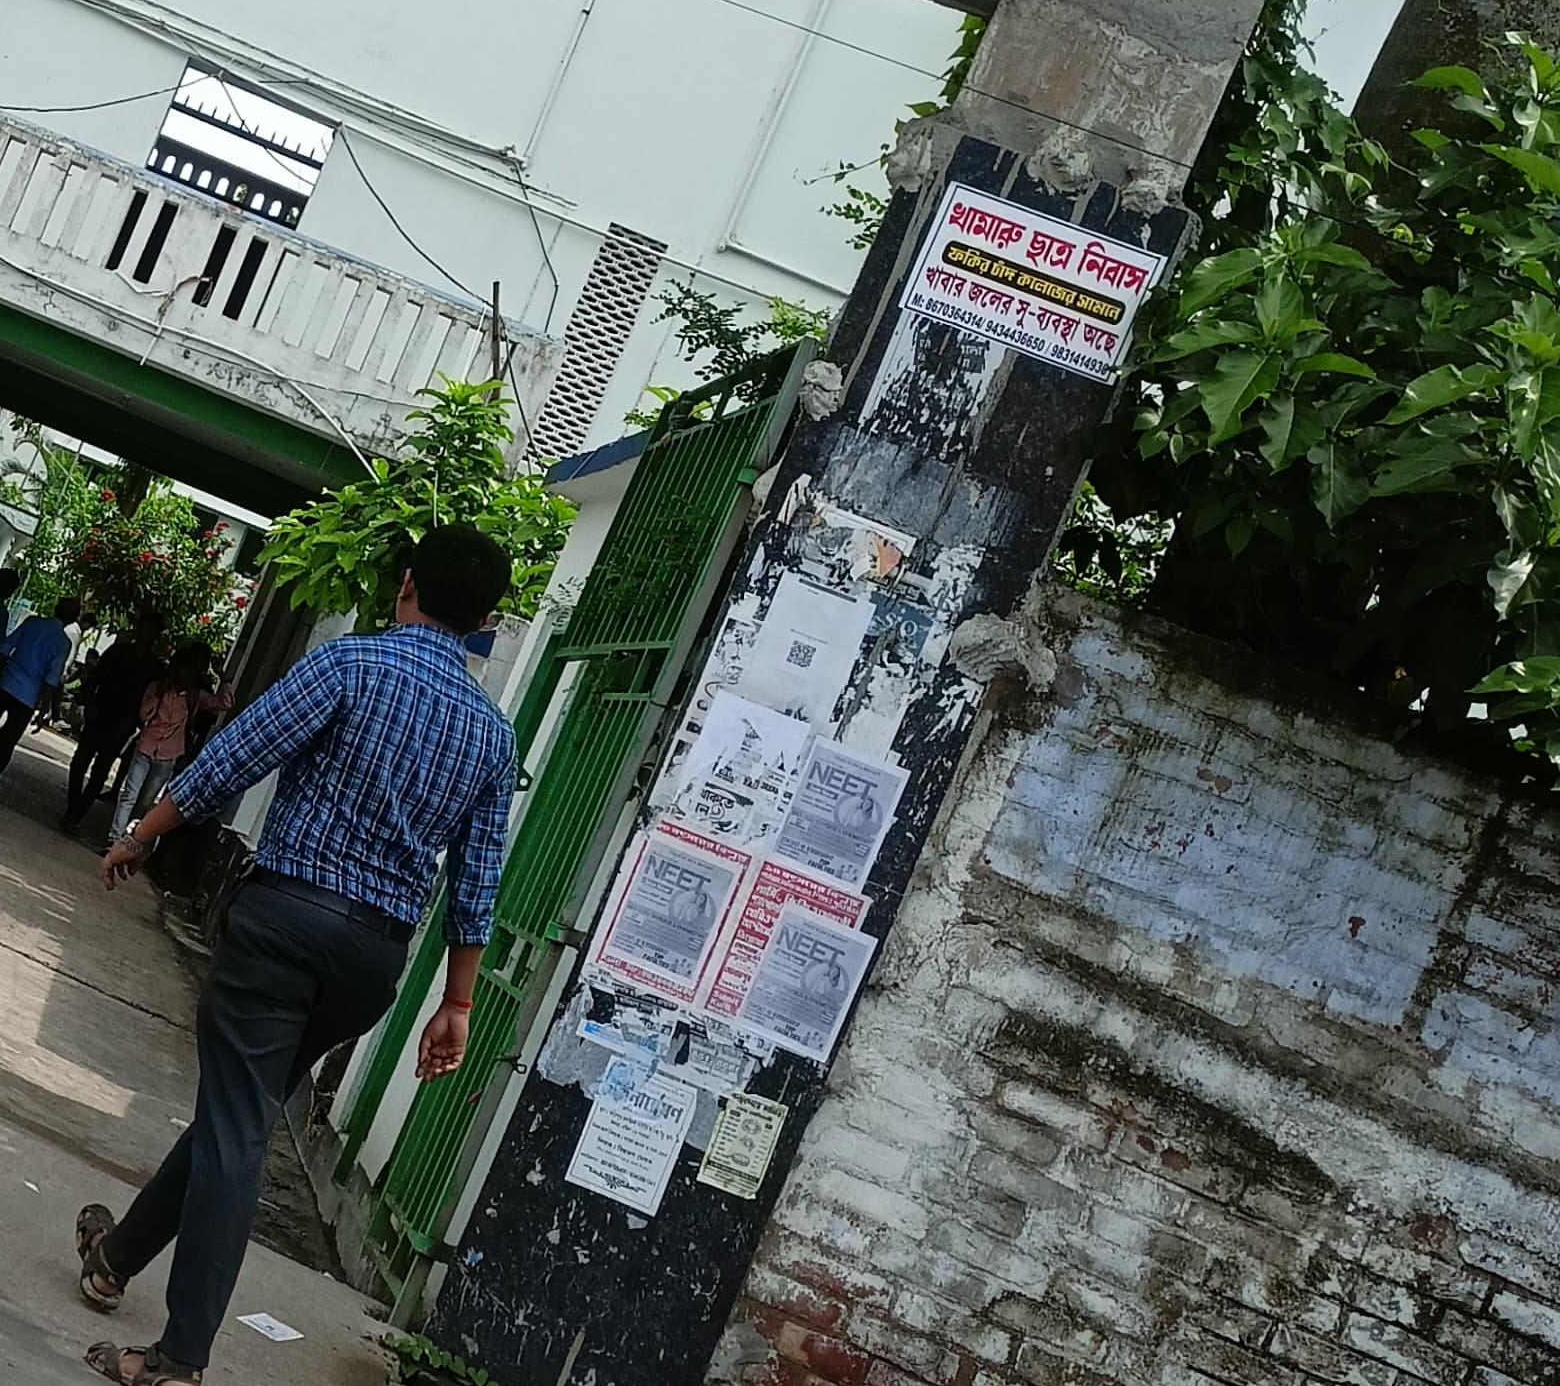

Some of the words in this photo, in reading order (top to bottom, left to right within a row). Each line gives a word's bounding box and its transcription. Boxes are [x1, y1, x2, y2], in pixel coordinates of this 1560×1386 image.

[1026, 230, 1077, 270] ছাত্র
[1077, 241, 1149, 296] নিবাস
[926, 265, 967, 298] খাবার
[968, 281, 1015, 316] জলের
[911, 292, 925, 308] M:
[984, 320, 1046, 352] 9434436650
[808, 760, 879, 804] NEET
[643, 854, 712, 899] NEET
[775, 925, 846, 972] NEET
